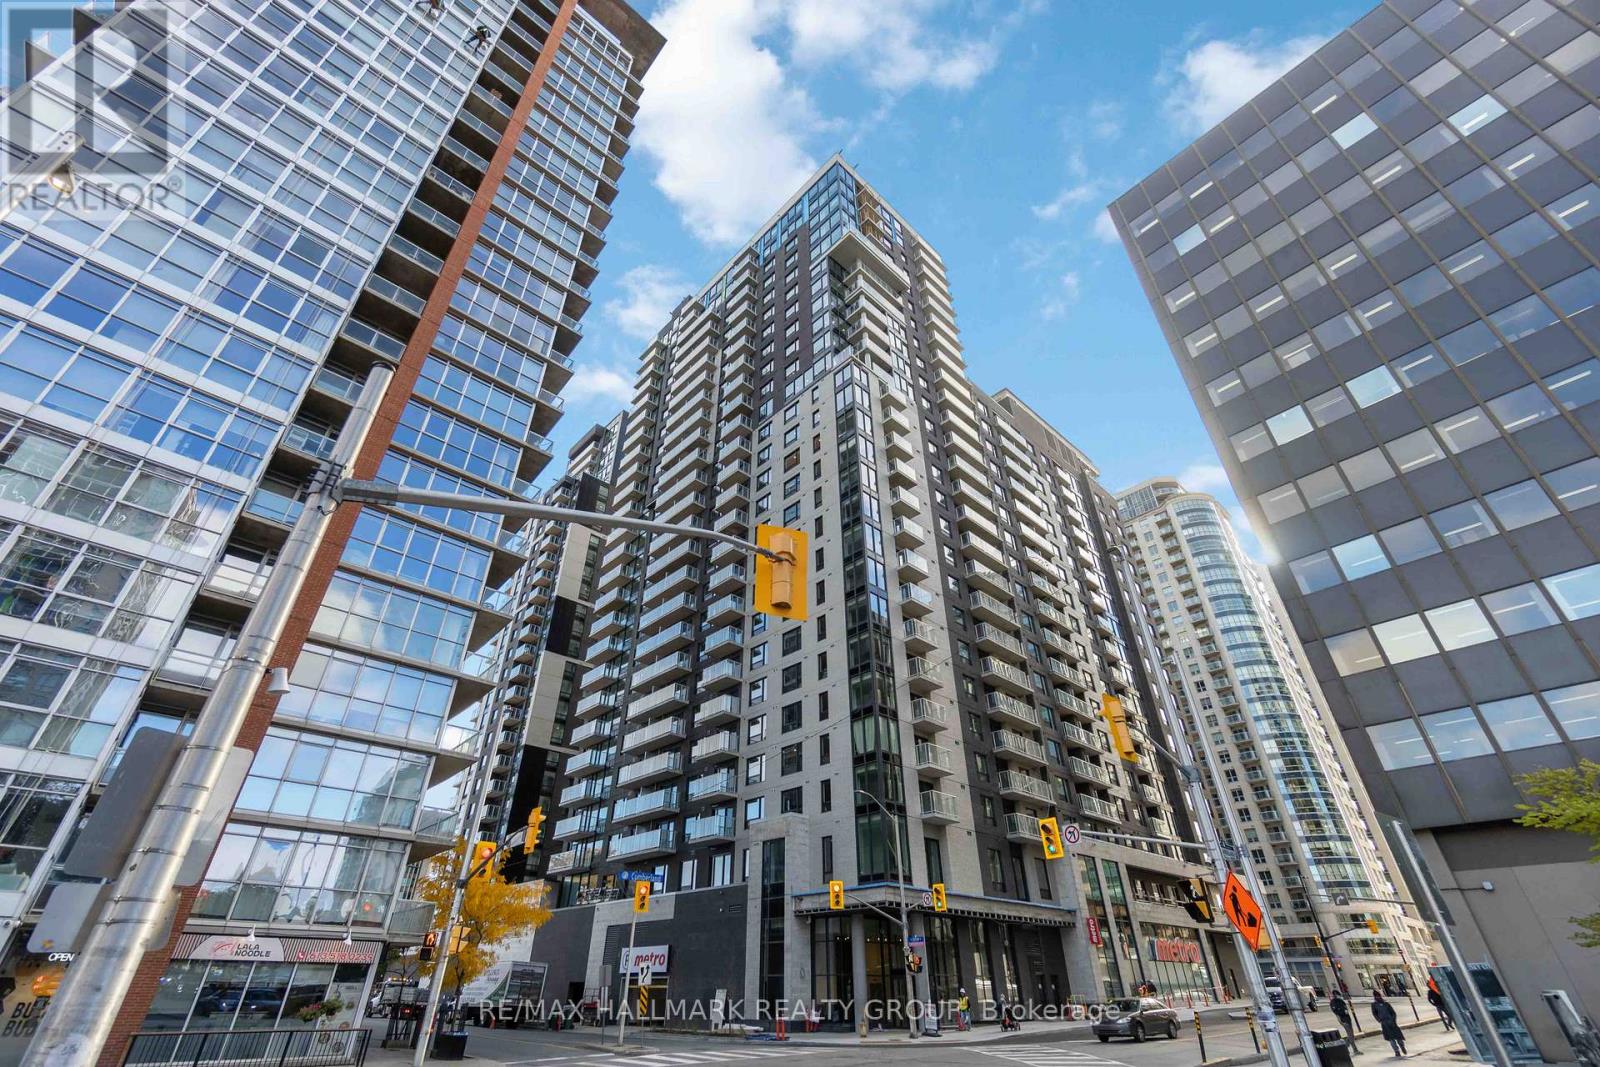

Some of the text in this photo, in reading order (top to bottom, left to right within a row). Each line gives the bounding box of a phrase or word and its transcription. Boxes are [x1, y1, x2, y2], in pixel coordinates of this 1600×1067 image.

[1088, 918, 1099, 943] metro
[237, 943, 260, 951] LALA
[1155, 939, 1201, 963] metro
[48, 953, 75, 961] OPEN
[234, 950, 271, 958] NOODLE
[634, 951, 665, 966] metro
